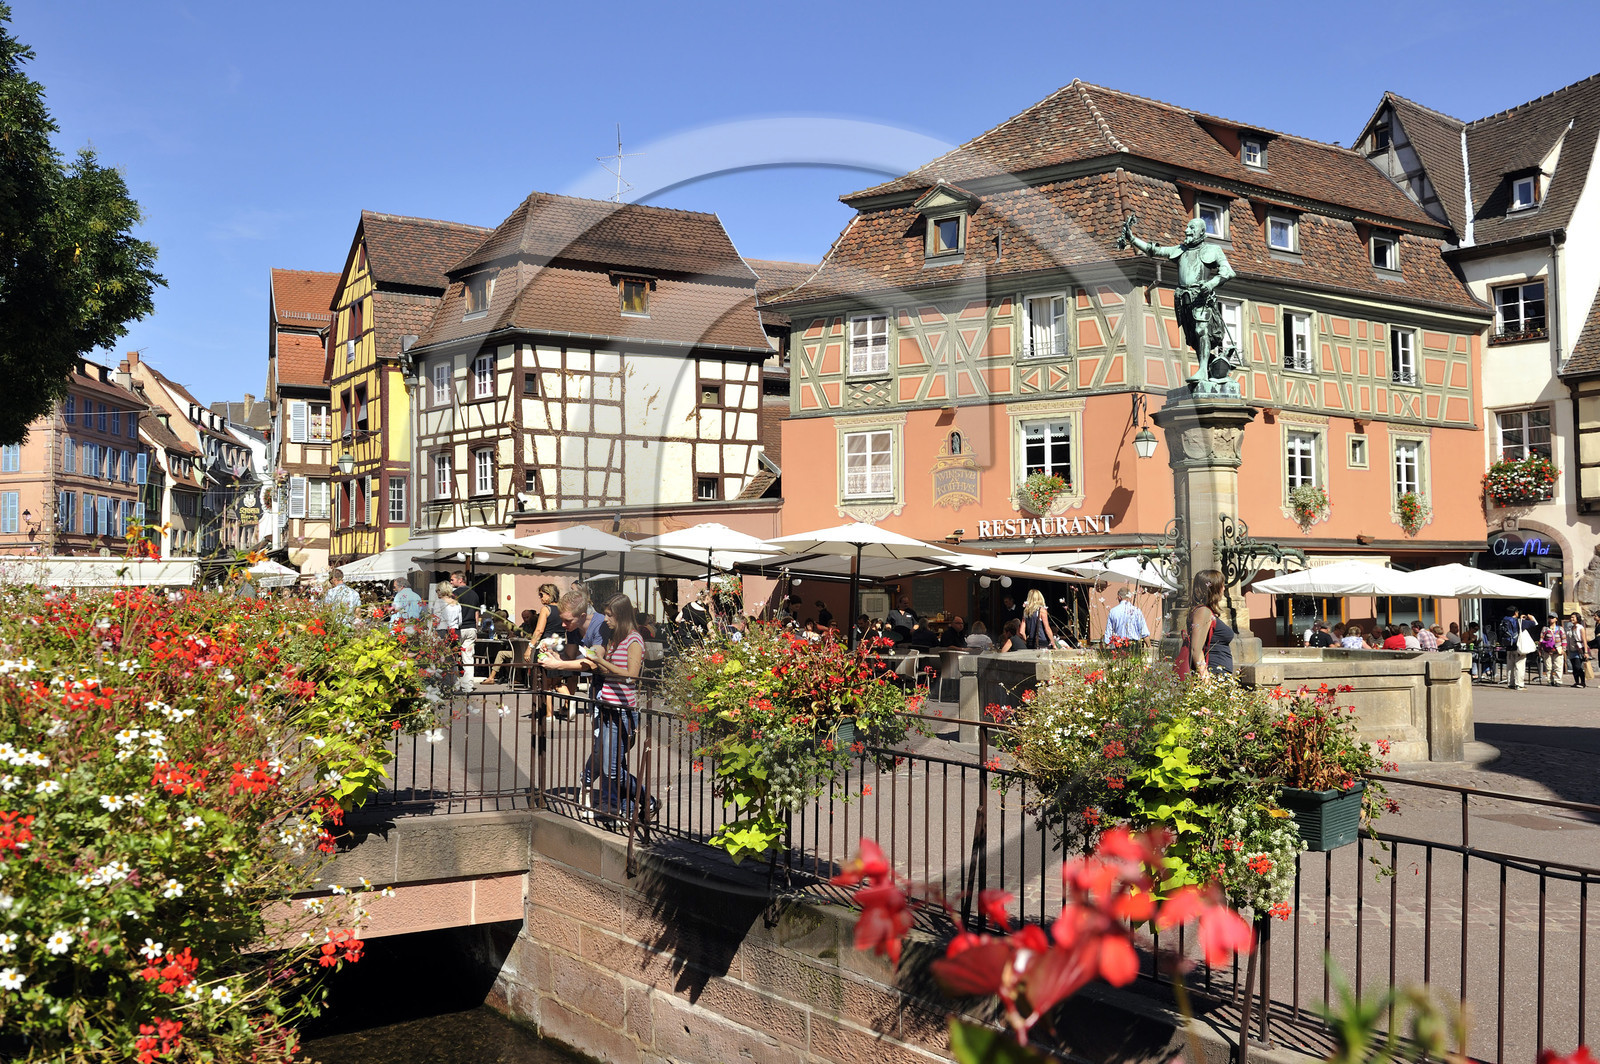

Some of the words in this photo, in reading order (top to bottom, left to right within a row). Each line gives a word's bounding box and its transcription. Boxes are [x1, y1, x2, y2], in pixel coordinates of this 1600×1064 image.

[978, 514, 1114, 537] RESTAURANT
[1493, 538, 1524, 556] Chez
[1523, 538, 1550, 556] Moi
